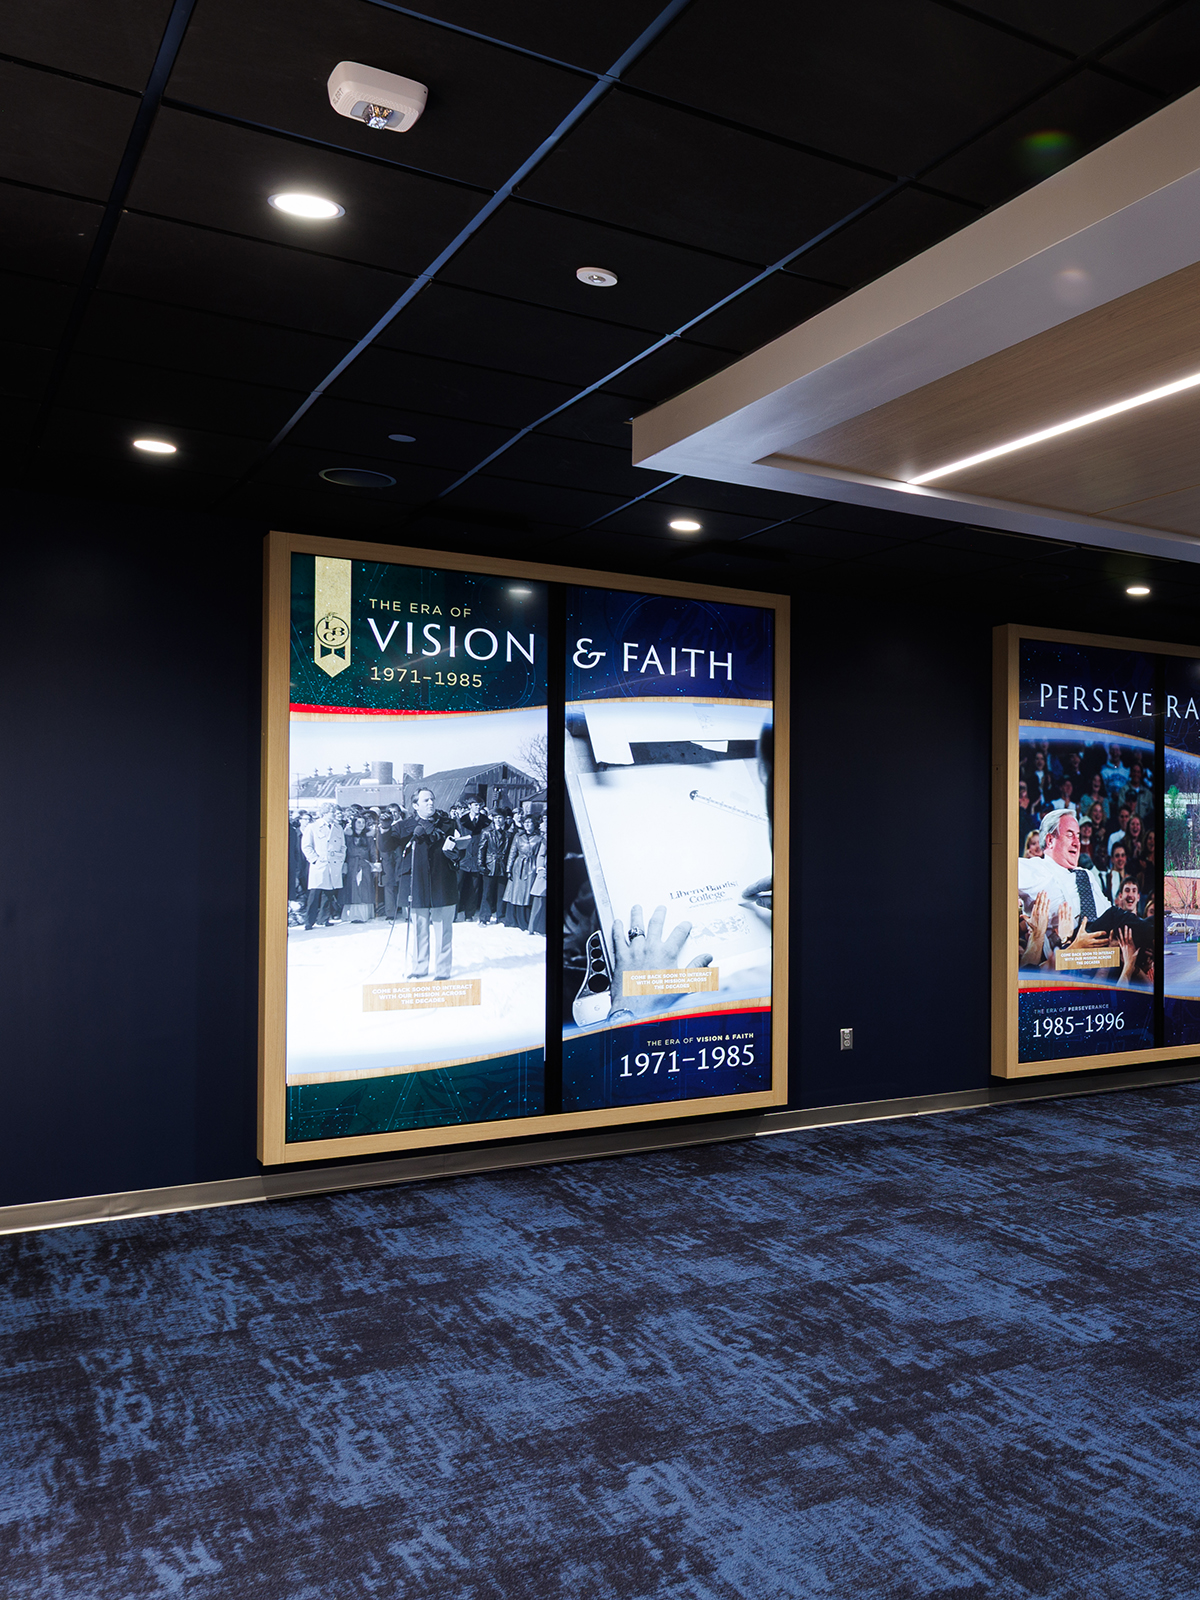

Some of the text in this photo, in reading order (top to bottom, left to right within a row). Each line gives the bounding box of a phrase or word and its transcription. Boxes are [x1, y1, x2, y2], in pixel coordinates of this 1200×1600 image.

[369, 598, 472, 618] THE ERA OF
[367, 617, 733, 680] VISION & FAITH
[370, 666, 483, 688] 1971-1985
[1033, 1012, 1125, 1038] 1985-1996
[620, 1044, 755, 1078] 1971-1985
